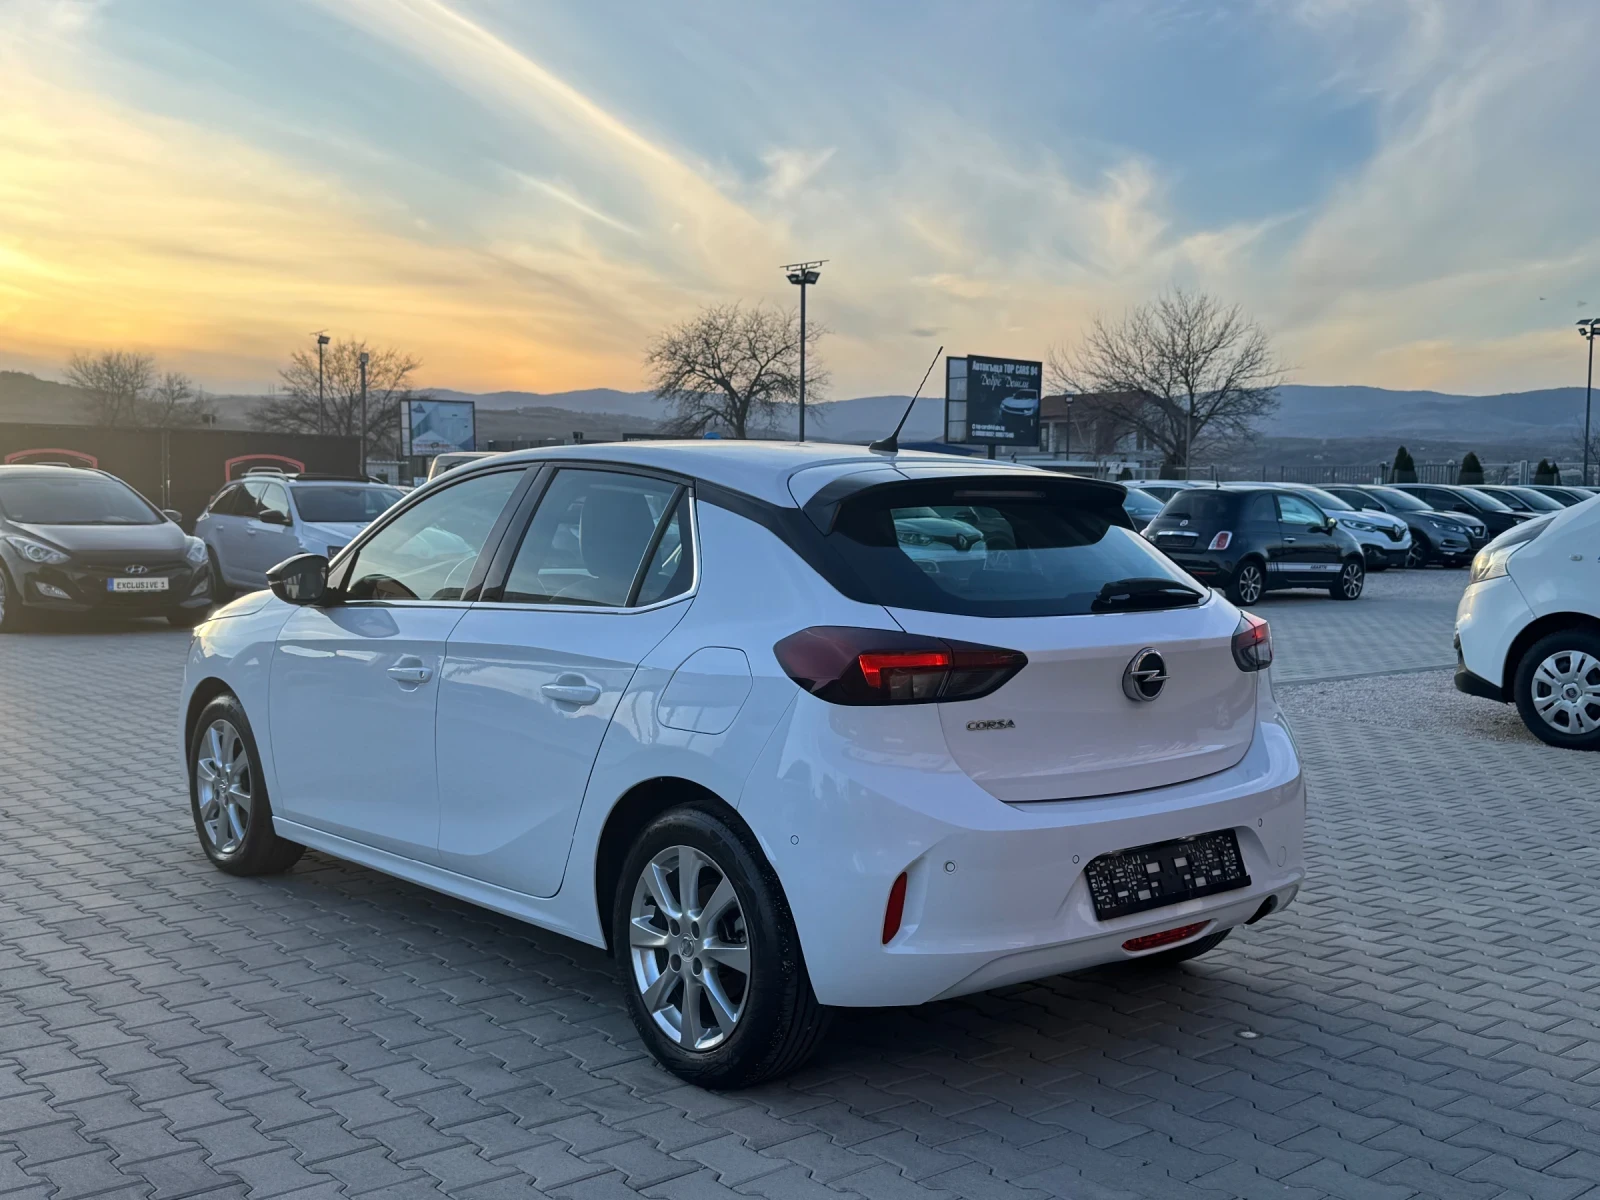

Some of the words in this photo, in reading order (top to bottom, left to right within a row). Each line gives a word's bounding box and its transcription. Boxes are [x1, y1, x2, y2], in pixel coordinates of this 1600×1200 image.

[1004, 363, 1015, 374] TOP
[116, 581, 159, 590] EXCLUSIVE
[966, 719, 1016, 731] CORSA
